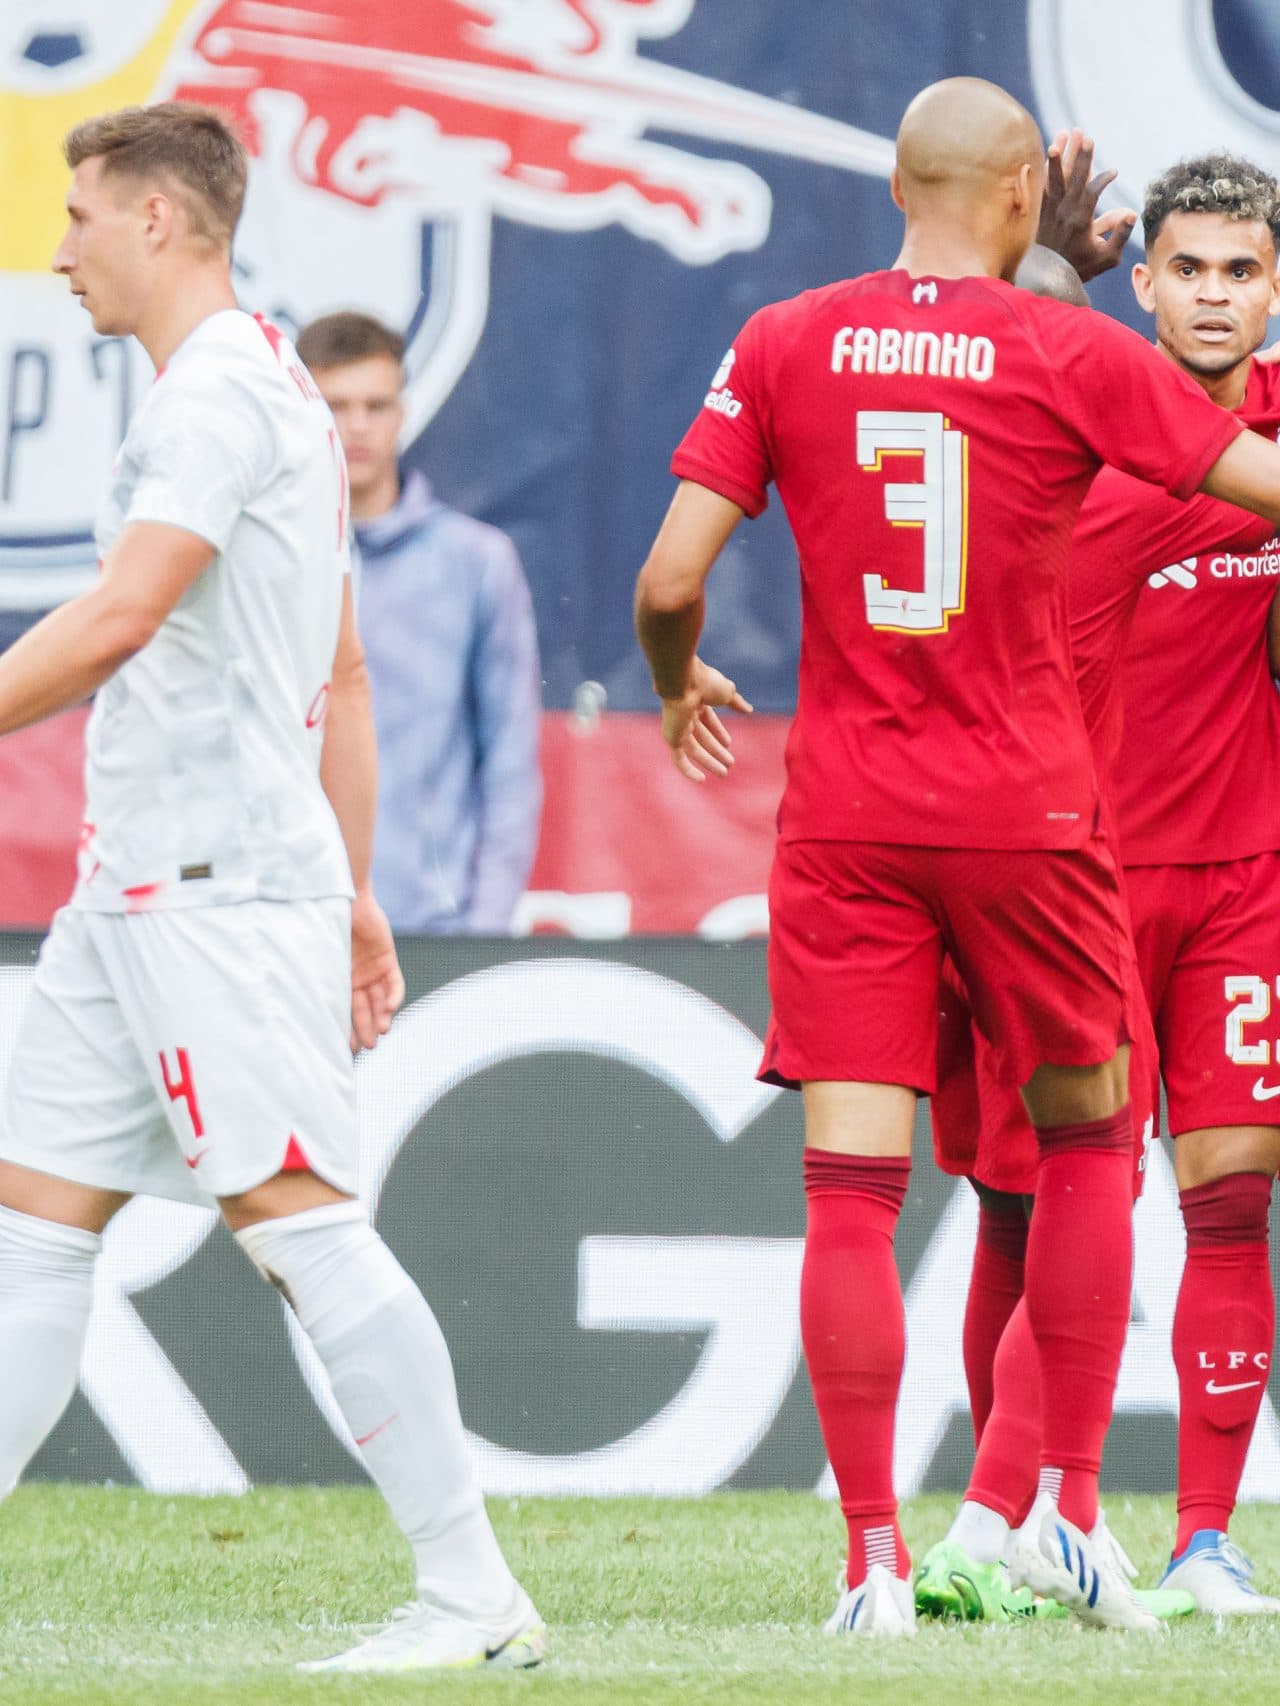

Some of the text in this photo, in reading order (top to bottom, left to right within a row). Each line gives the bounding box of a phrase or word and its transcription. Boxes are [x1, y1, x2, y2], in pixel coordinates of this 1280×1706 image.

[830, 326, 995, 382] FABINHO
[856, 410, 969, 635] 3
[158, 1046, 206, 1139] 4
